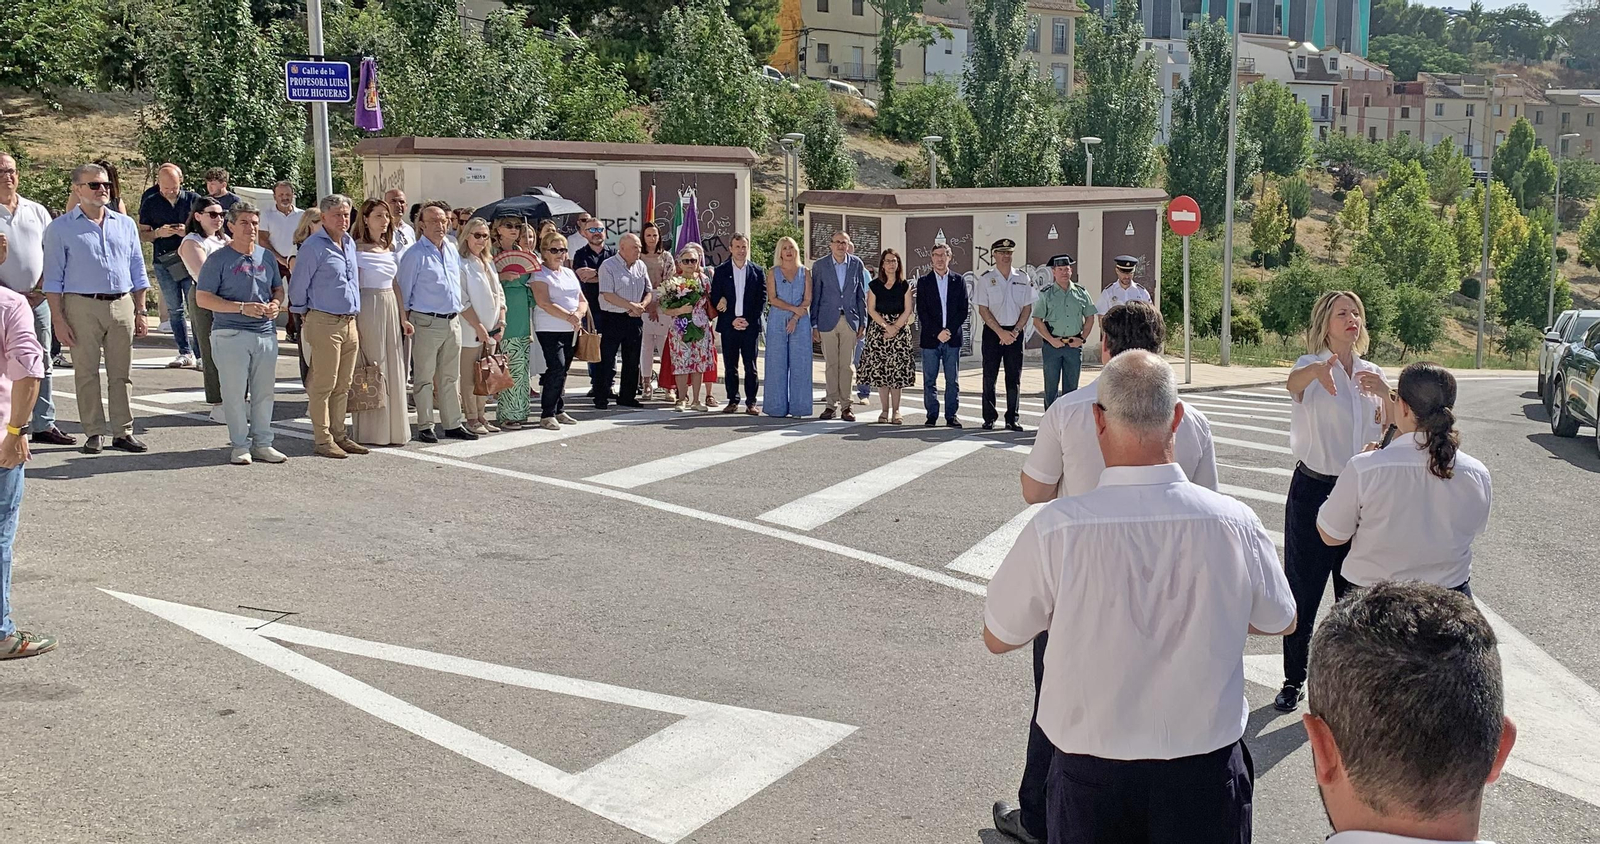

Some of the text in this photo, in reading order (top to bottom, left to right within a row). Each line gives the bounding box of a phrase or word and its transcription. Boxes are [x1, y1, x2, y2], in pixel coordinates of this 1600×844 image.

[302, 67, 335, 75] Calle de la
[290, 77, 348, 87] PROFESORA LUISA
[292, 88, 347, 98] RUIZ HIGUERAS
